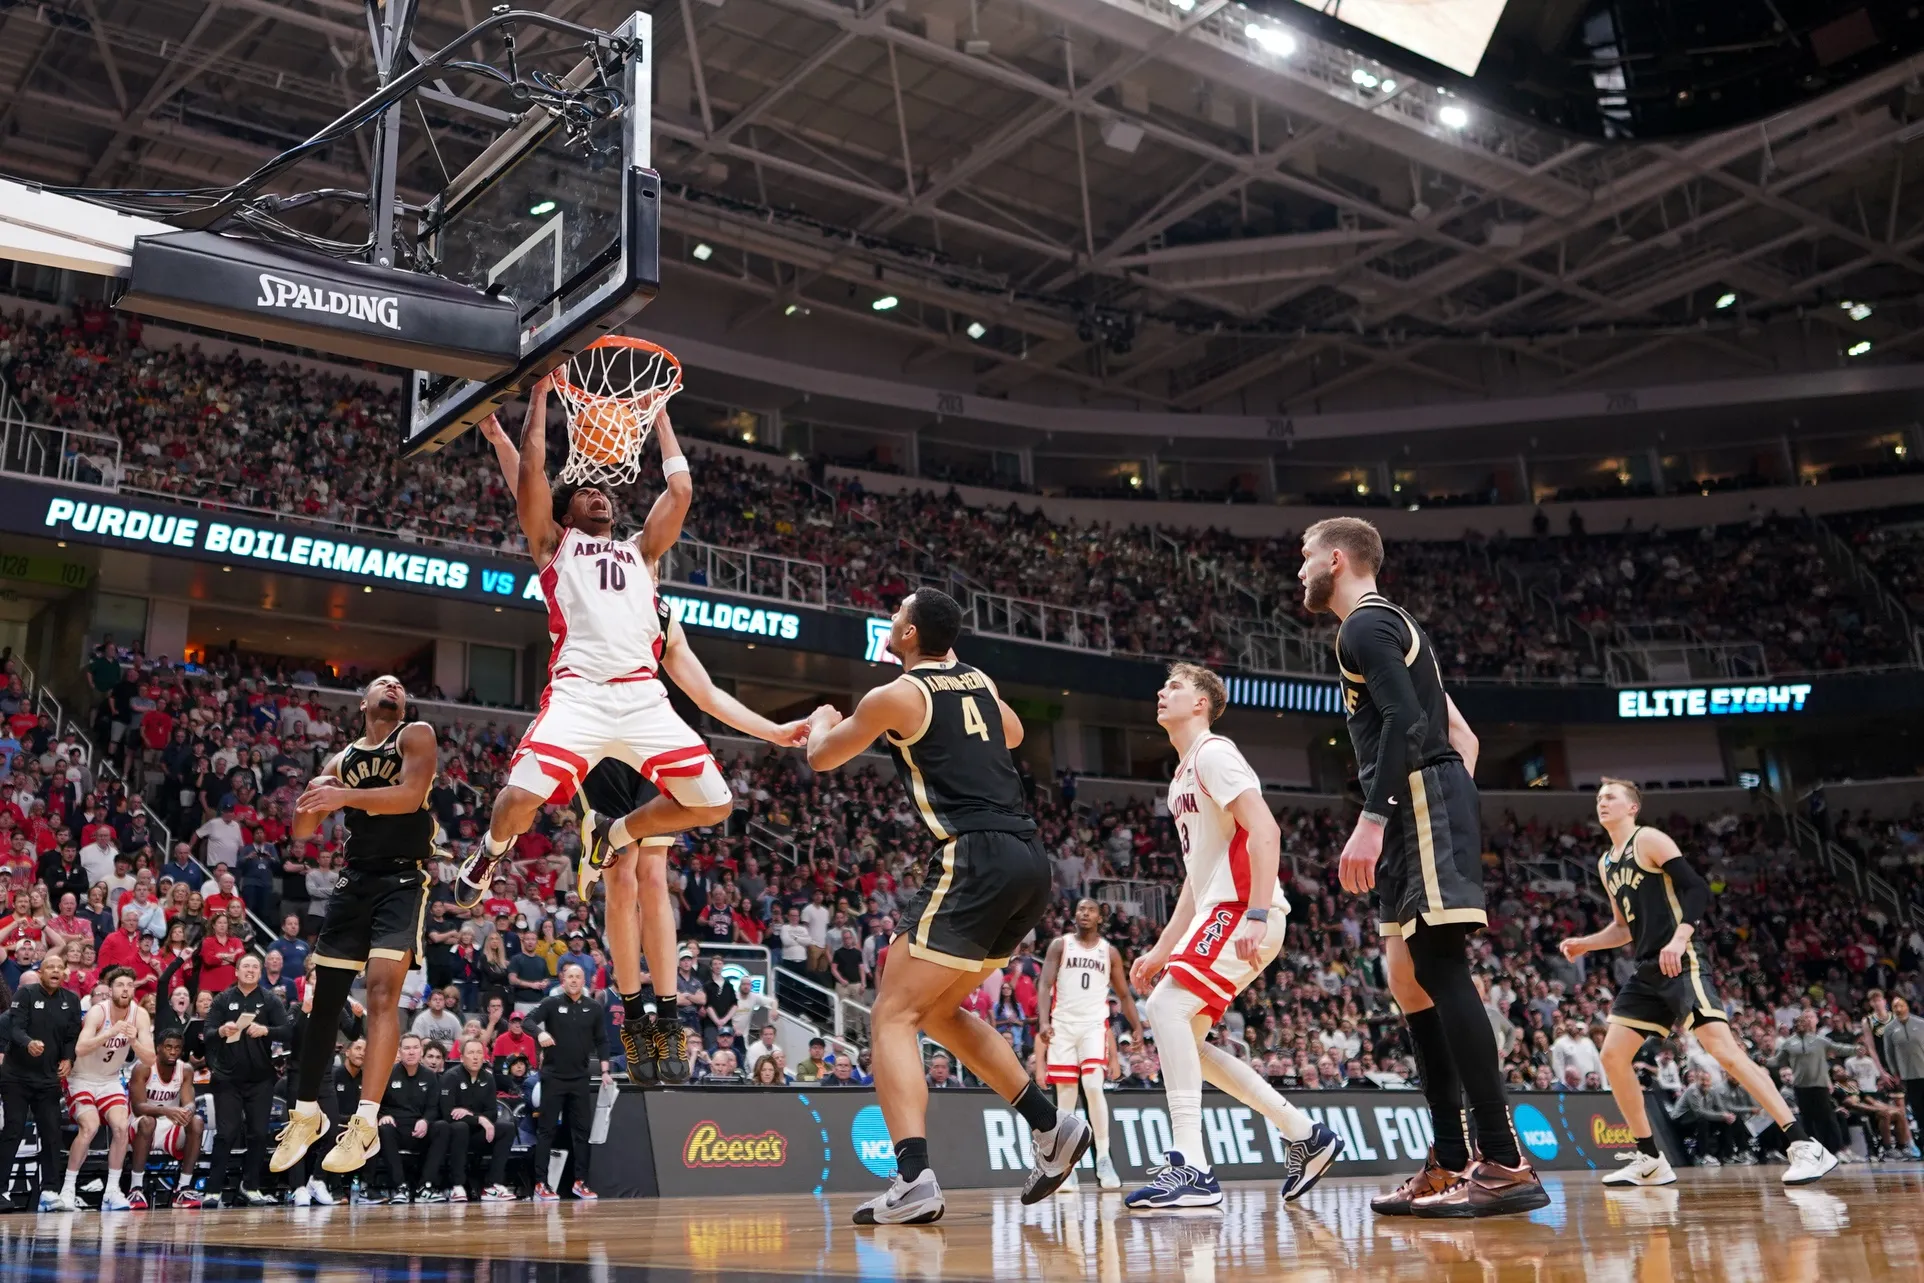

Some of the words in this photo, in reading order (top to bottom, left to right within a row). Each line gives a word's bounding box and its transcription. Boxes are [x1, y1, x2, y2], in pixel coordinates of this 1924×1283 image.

[257, 273, 401, 331] SPALDING
[45, 498, 199, 548] PURDUE
[204, 523, 469, 590] BOILERMAKERS
[481, 568, 515, 596] VS
[574, 542, 637, 567] ARIZNA
[62, 562, 86, 585] 101
[595, 558, 626, 592] 10
[663, 595, 799, 640] WILDCATS
[1618, 689, 1707, 717] ELITE
[1709, 684, 1812, 714] EIGHT
[961, 696, 990, 741] 4
[1622, 896, 1636, 923] 2
[714, 923, 729, 935] 25
[1194, 910, 1234, 956] CATS
[1065, 957, 1106, 975] ARIZONA
[1081, 972, 1090, 990] 0
[102, 1050, 115, 1063] 3
[687, 1125, 783, 1163] Reese's
[1523, 1130, 1559, 1147] NCAA
